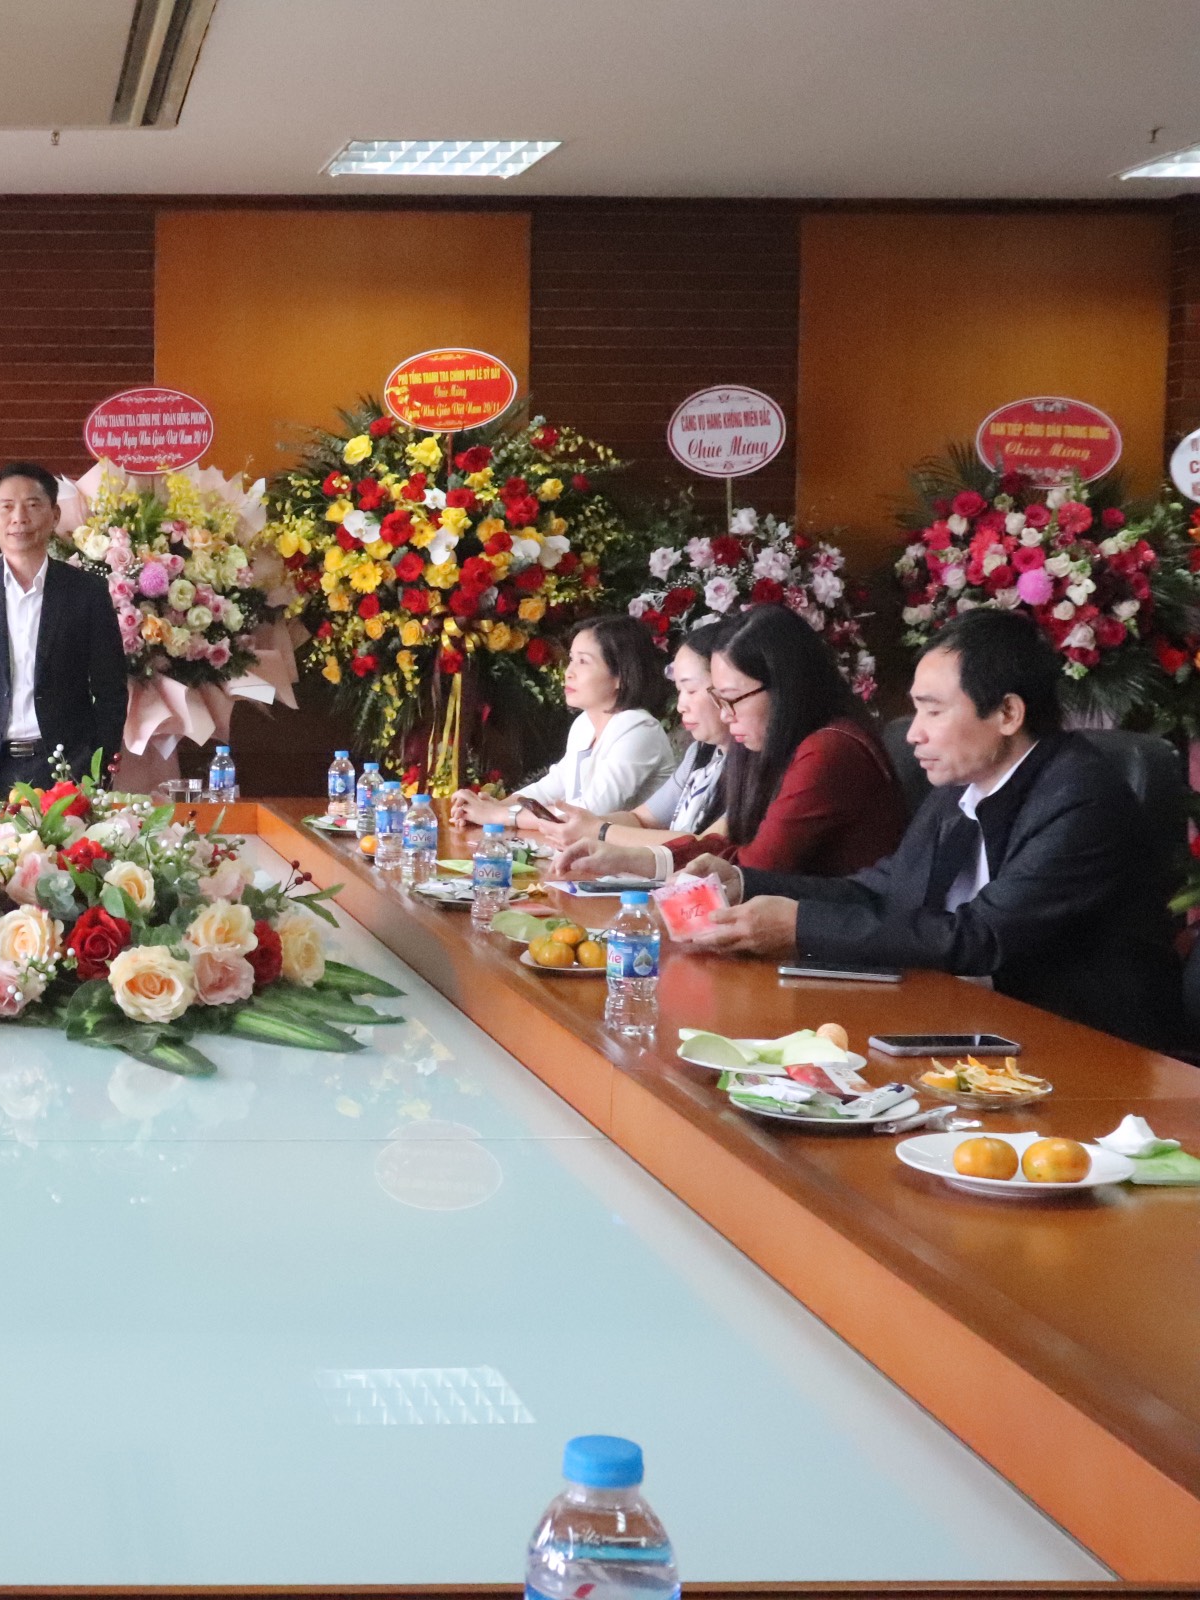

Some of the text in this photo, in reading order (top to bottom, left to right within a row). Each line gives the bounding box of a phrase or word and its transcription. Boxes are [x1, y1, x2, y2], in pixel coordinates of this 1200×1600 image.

[422, 372, 439, 383] THANH
[439, 370, 449, 382] TRA
[109, 414, 125, 428] THANH
[126, 414, 136, 427] TRA
[688, 435, 769, 459] Chúc Mừng
[1005, 442, 1041, 457] Chúc
